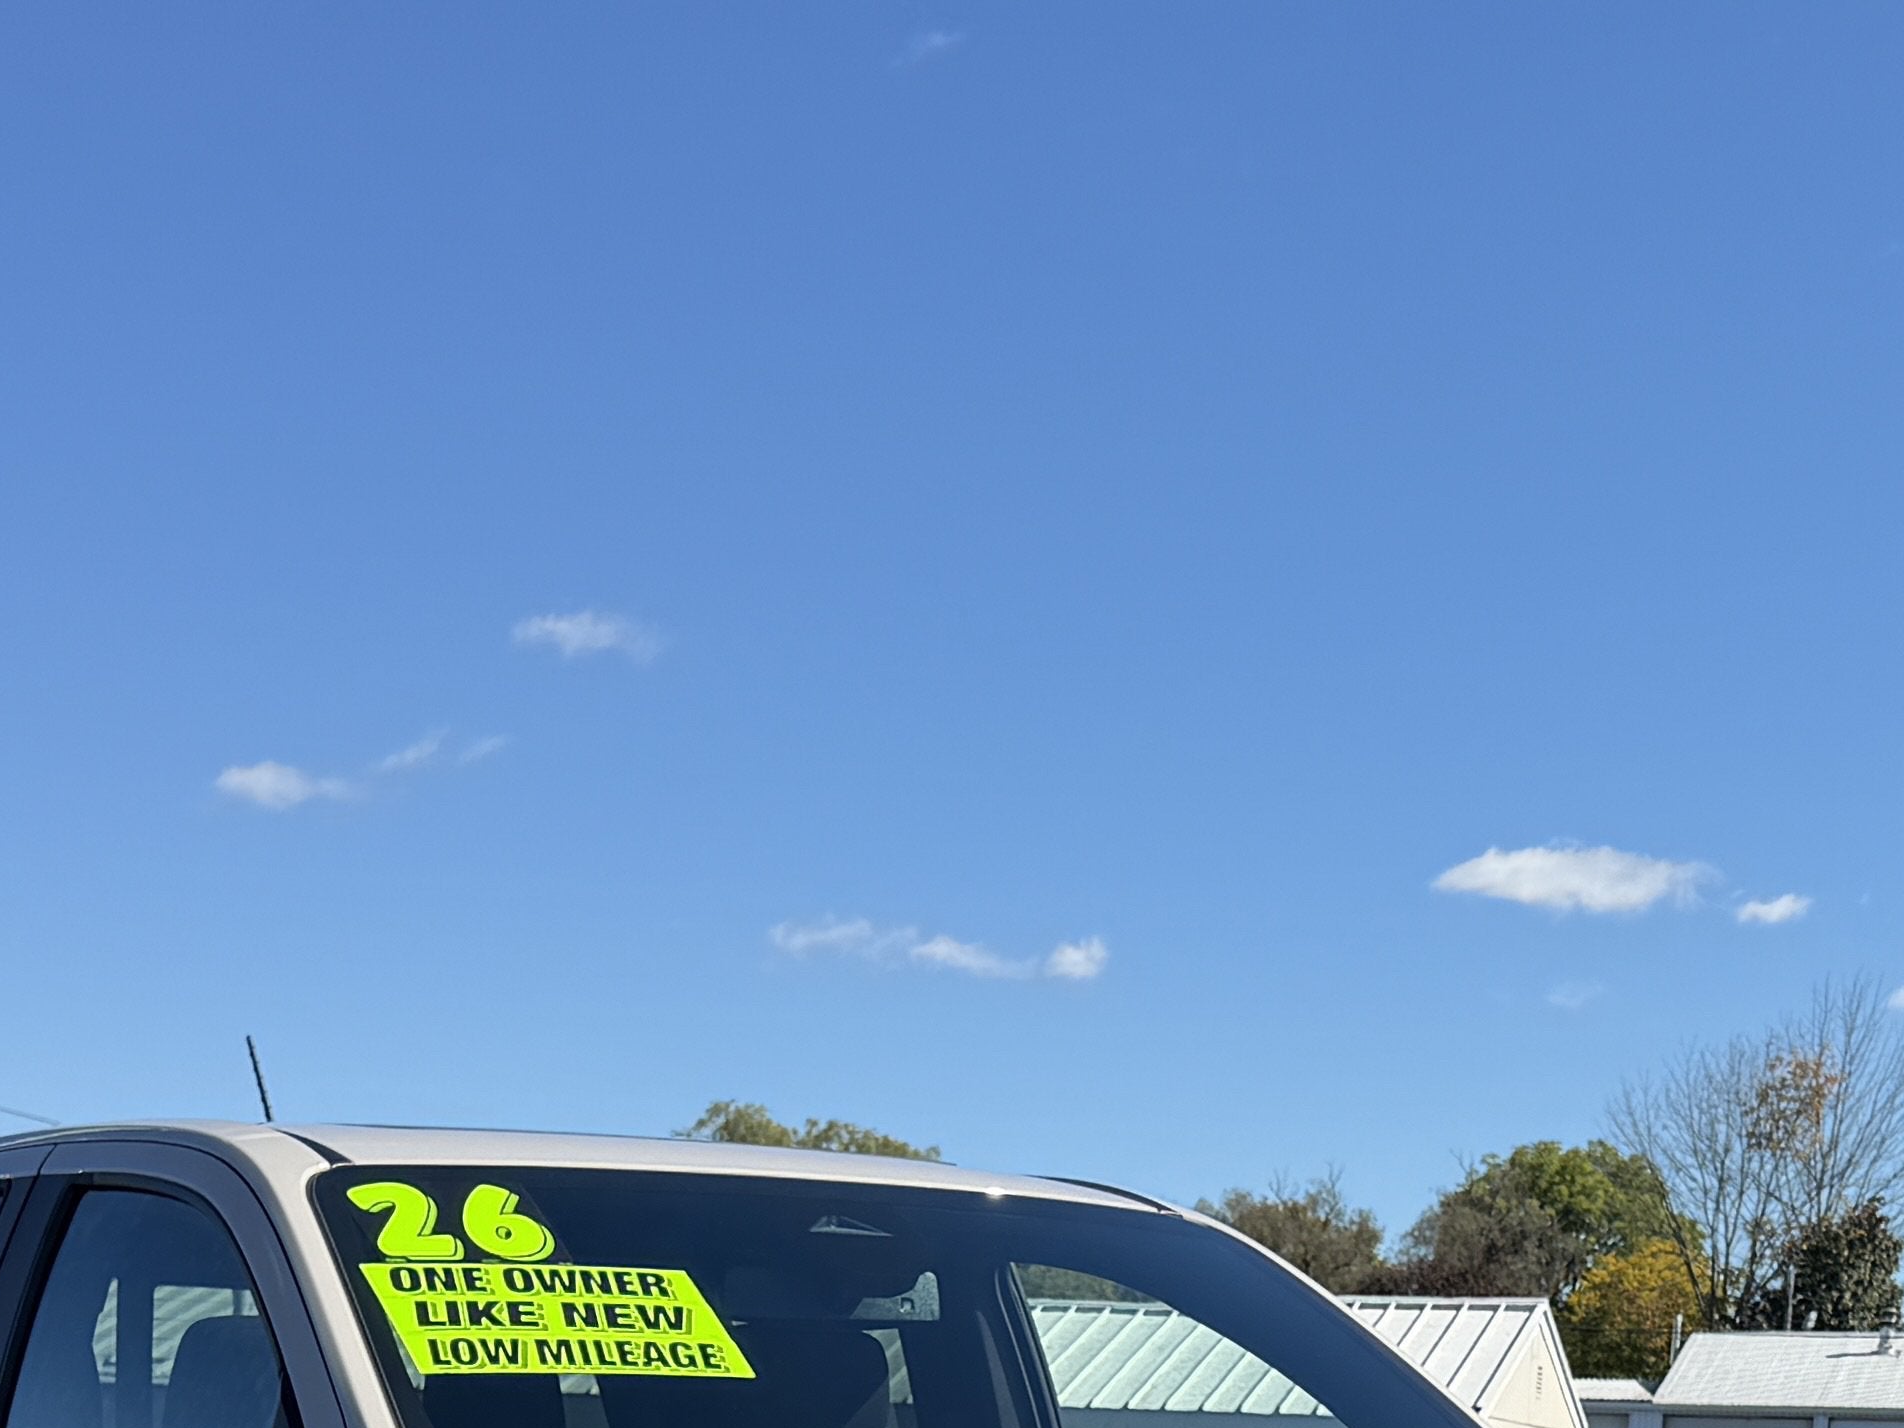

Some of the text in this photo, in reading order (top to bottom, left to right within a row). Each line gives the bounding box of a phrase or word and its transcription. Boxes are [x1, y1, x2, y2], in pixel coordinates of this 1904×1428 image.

[346, 1182, 555, 1261] 26
[388, 1266, 674, 1299] ONE OWNER
[414, 1300, 688, 1333] LIKE NEW
[427, 1337, 728, 1372] LOW MILEAGE
